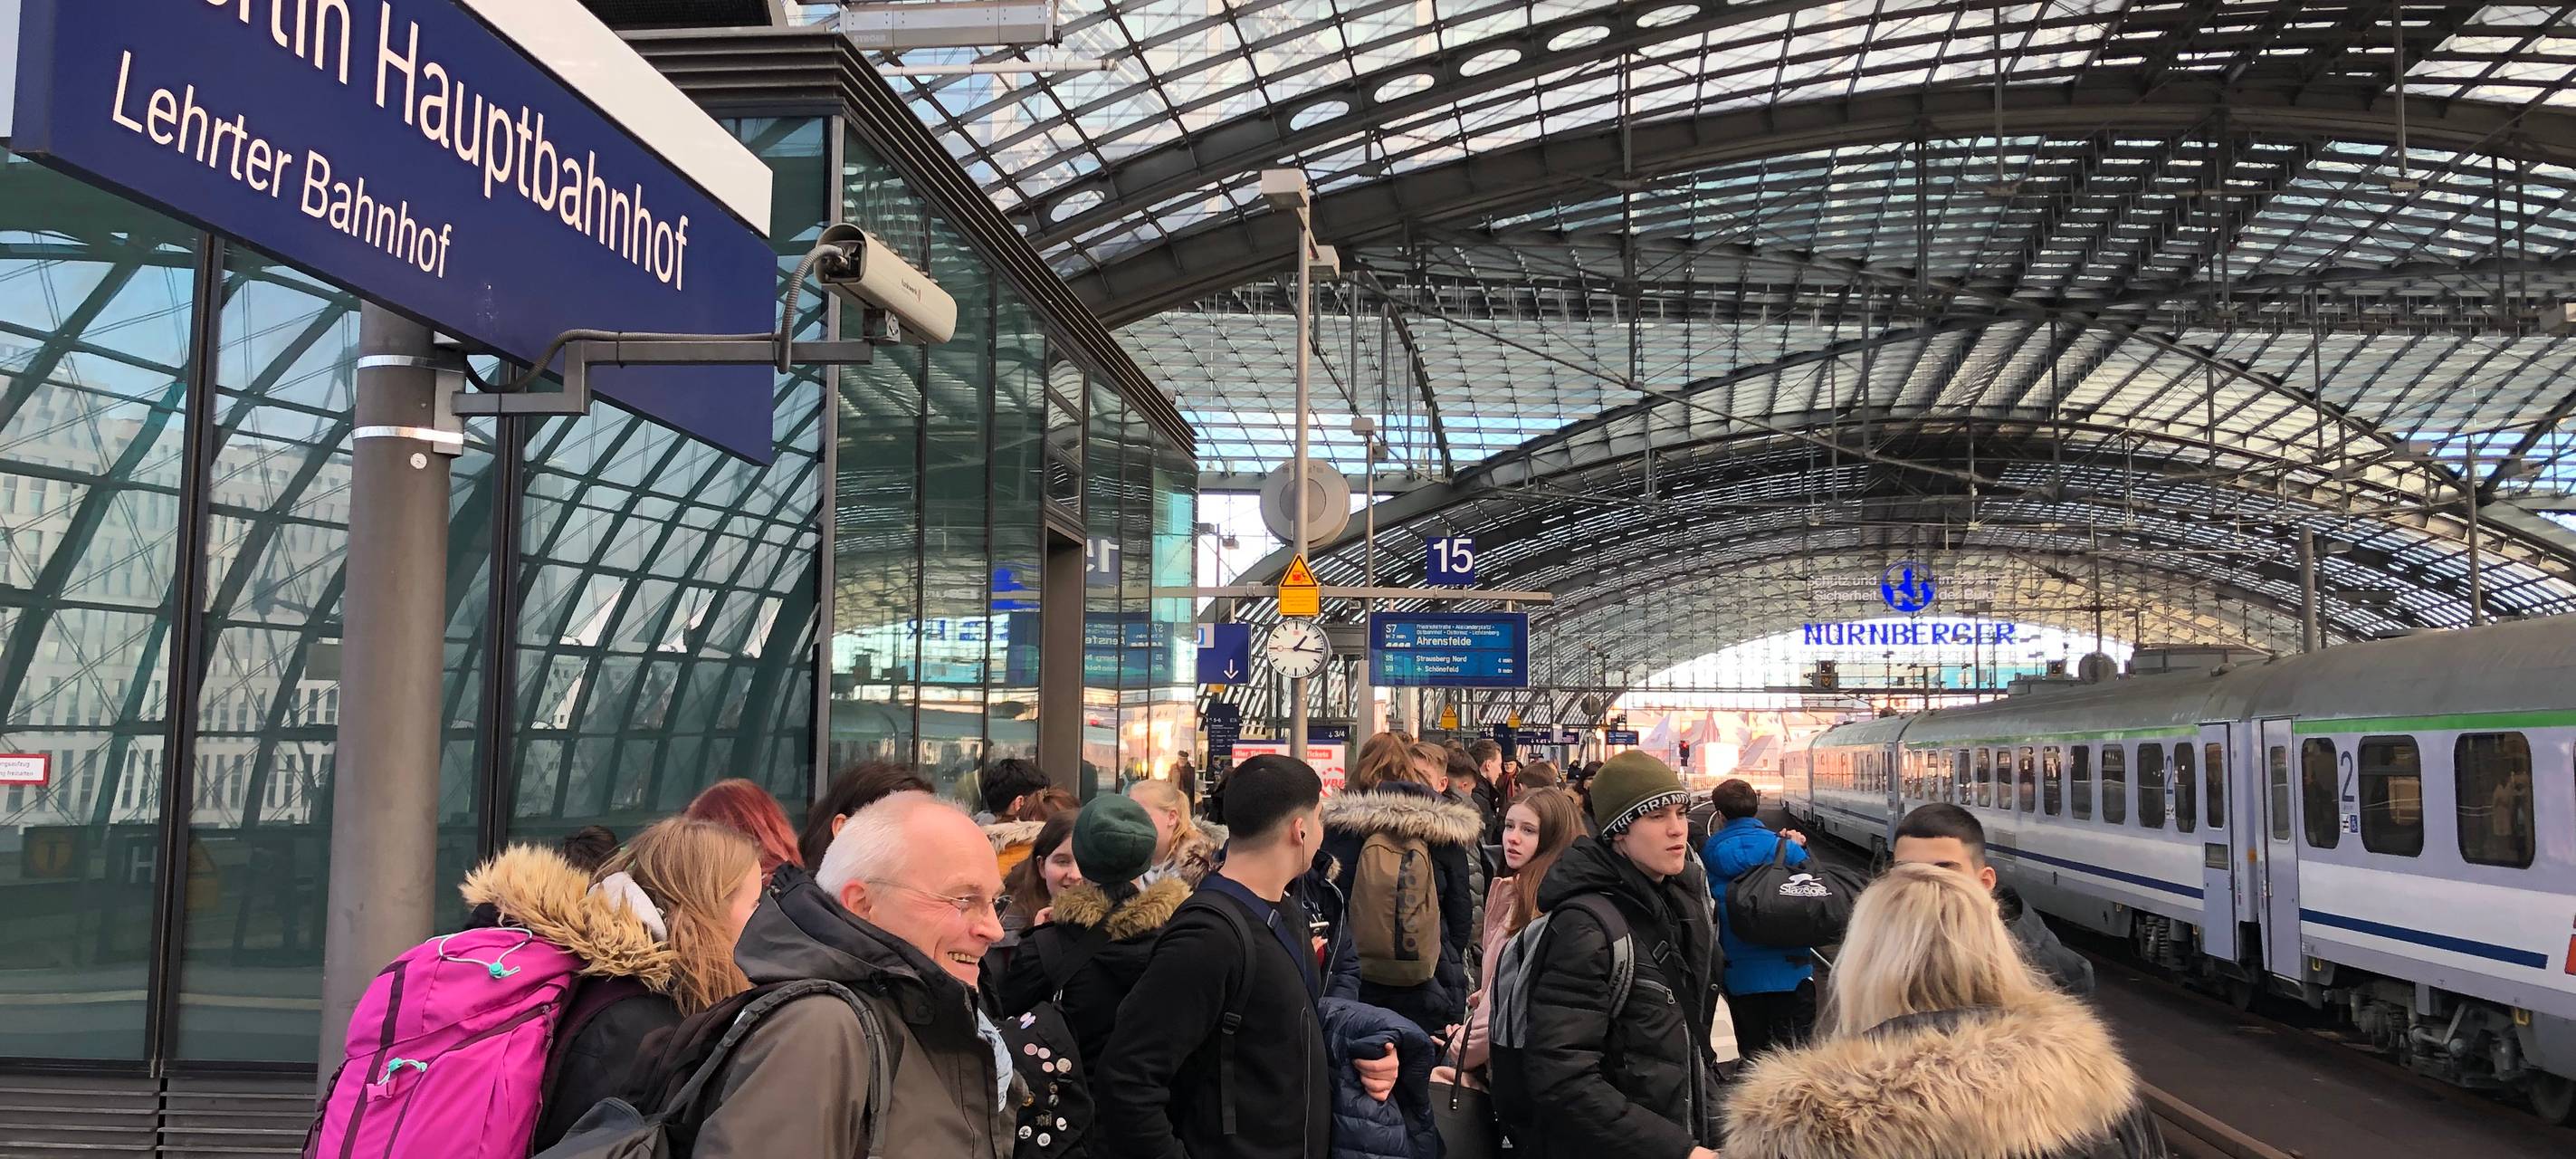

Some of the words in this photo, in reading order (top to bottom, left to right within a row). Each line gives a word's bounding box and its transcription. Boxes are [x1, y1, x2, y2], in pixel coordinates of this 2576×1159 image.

[376, 0, 689, 291] Hauptbahnhof
[112, 51, 291, 198] Lehrter
[301, 149, 452, 278] Bahnhof
[1433, 538, 1474, 573] 15
[1853, 575, 1877, 586] und
[1813, 589, 1877, 601] Sicherheit
[1386, 624, 1397, 633] S7
[1416, 637, 1472, 647] Ahrensfelde
[1416, 655, 1451, 664] Strausberg
[1425, 665, 1459, 674] Schönefeld
[2166, 755, 2172, 794] 2
[2341, 751, 2355, 802] 2
[1611, 812, 1634, 833] THE
[1637, 793, 1689, 816] BRAND
